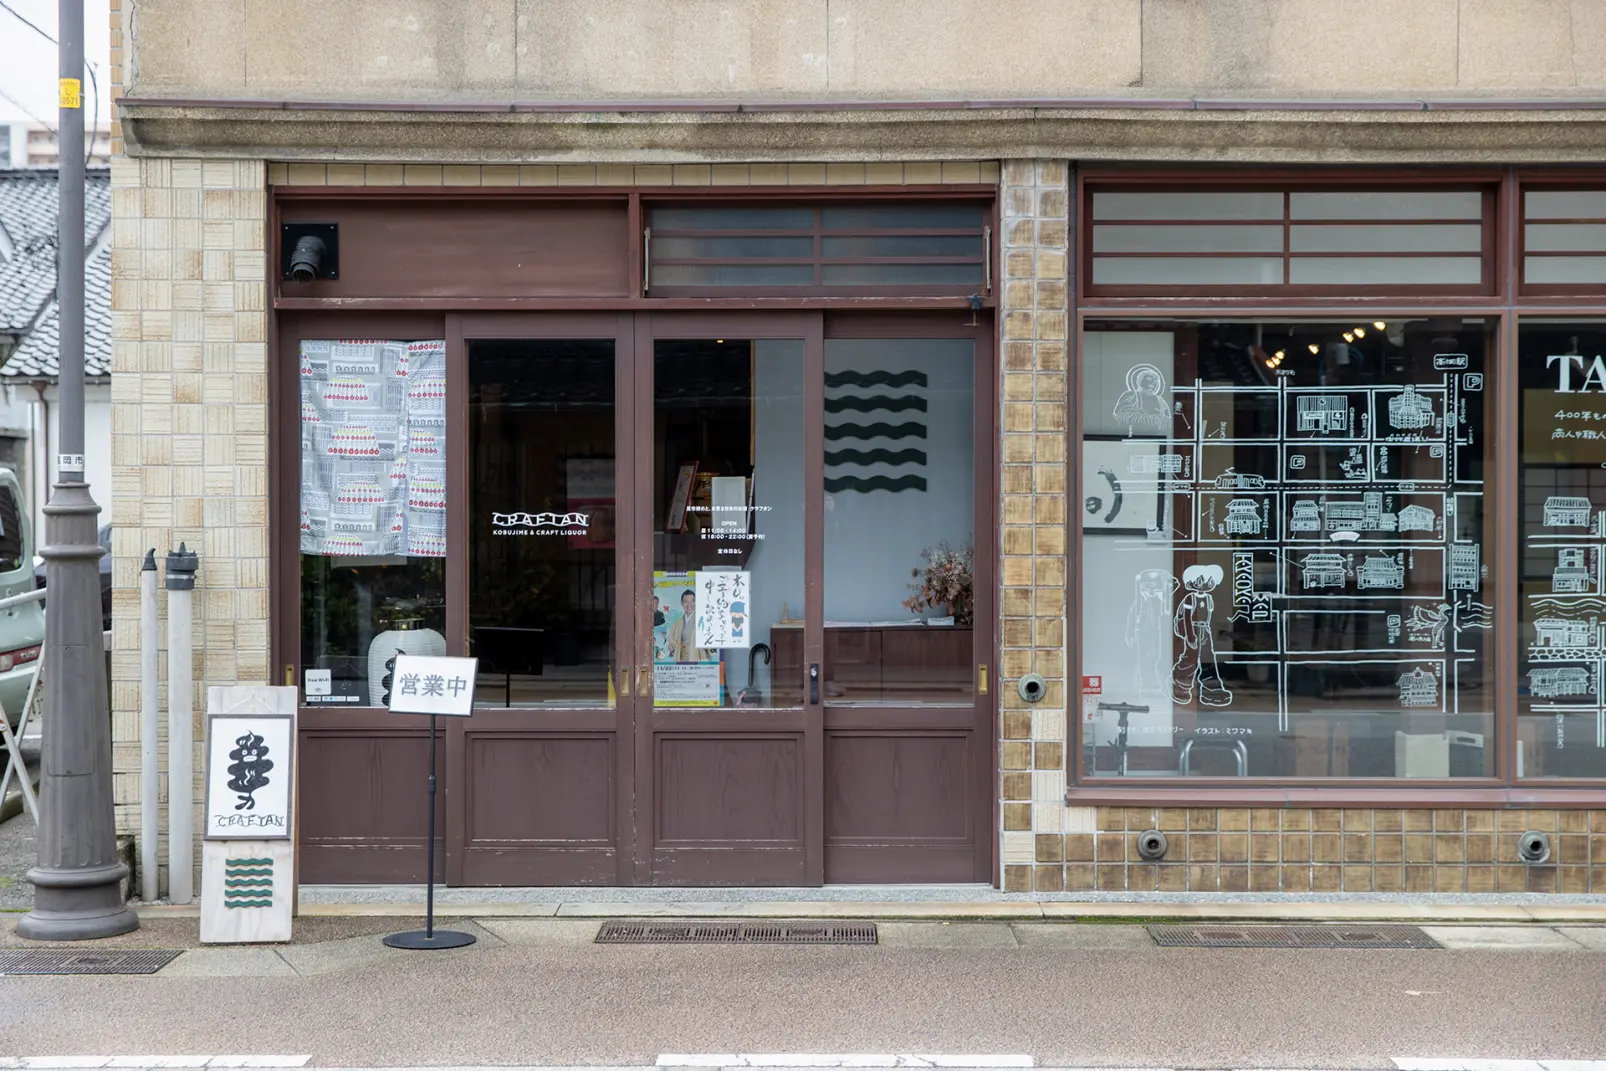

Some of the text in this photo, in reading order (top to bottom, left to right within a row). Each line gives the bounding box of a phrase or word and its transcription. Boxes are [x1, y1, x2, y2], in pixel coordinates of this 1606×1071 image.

[58, 455, 83, 465] 岡市
[492, 512, 589, 527] CRAFTAN
[399, 672, 467, 698] 営業中
[214, 814, 284, 828] CRAFTAN
